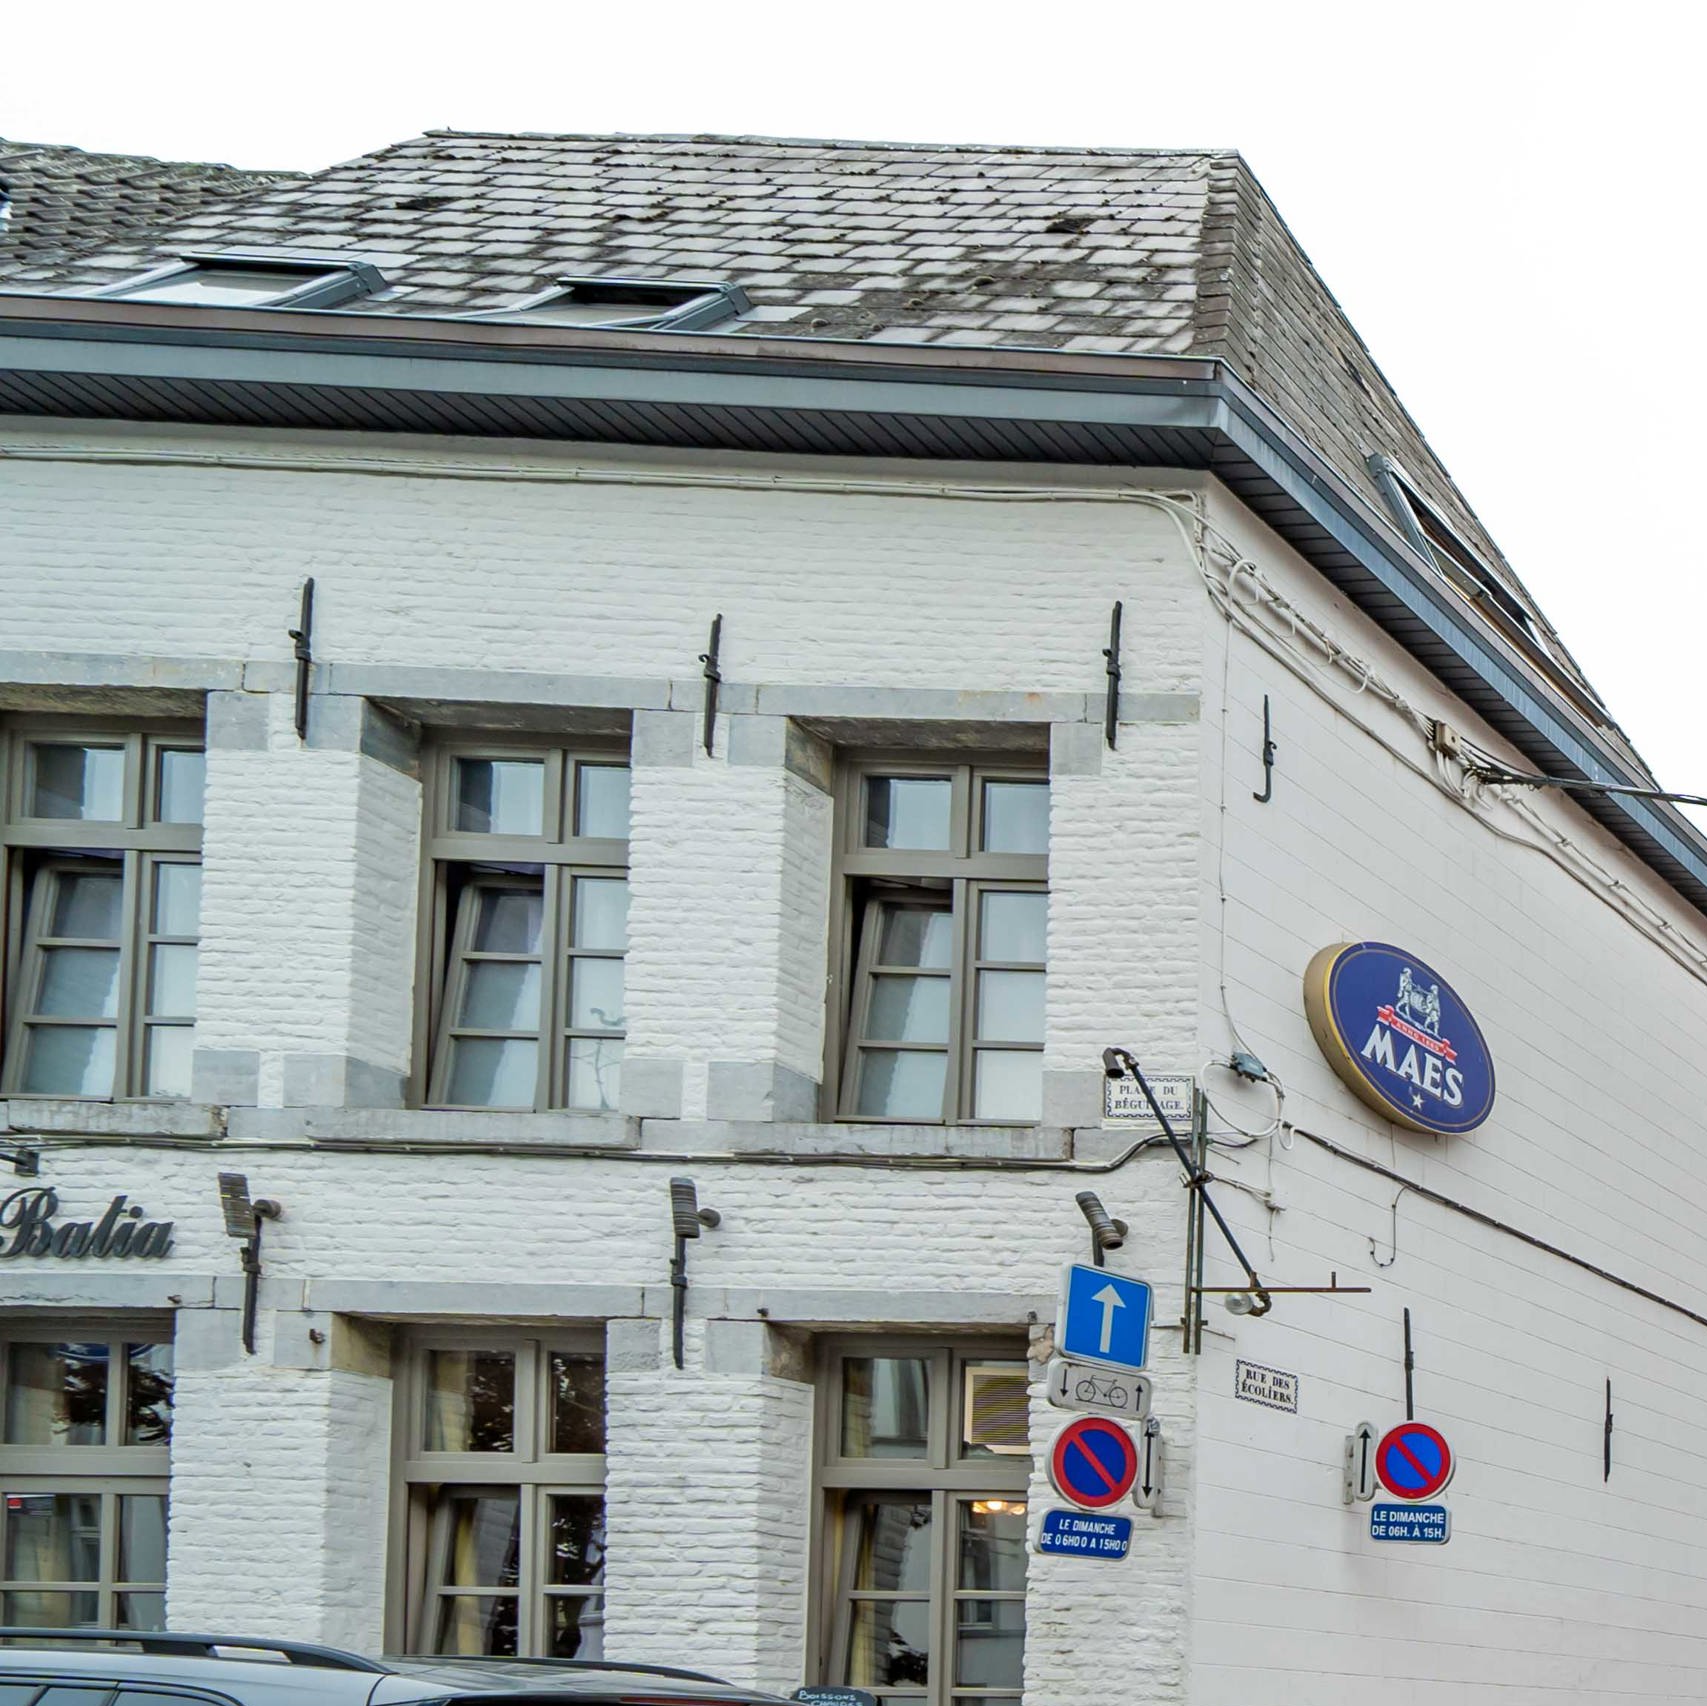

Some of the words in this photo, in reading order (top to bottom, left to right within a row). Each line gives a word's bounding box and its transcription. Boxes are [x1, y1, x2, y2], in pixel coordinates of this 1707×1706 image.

[1361, 1023, 1463, 1106] MAES
[1119, 1085, 1156, 1095] PLAE
[1163, 1086, 1178, 1096] DU
[1114, 1097, 1184, 1110] BÉGUIAGE.
[0, 1186, 175, 1259] Batia
[1246, 1369, 1267, 1384] RUE
[1272, 1376, 1290, 1390] DES
[1241, 1378, 1294, 1405] ÉCOLIERS.
[1374, 1511, 1387, 1521] LE
[1389, 1511, 1445, 1524] DIMANCHE
[1059, 1519, 1071, 1530] LE
[1073, 1520, 1116, 1535] DIMANCHE
[1372, 1525, 1386, 1536] DE
[1388, 1526, 1410, 1537] 06H.
[1412, 1524, 1421, 1538] À
[1423, 1527, 1445, 1539] 15H.
[1041, 1533, 1053, 1545] DE
[1090, 1538, 1096, 1549] A
